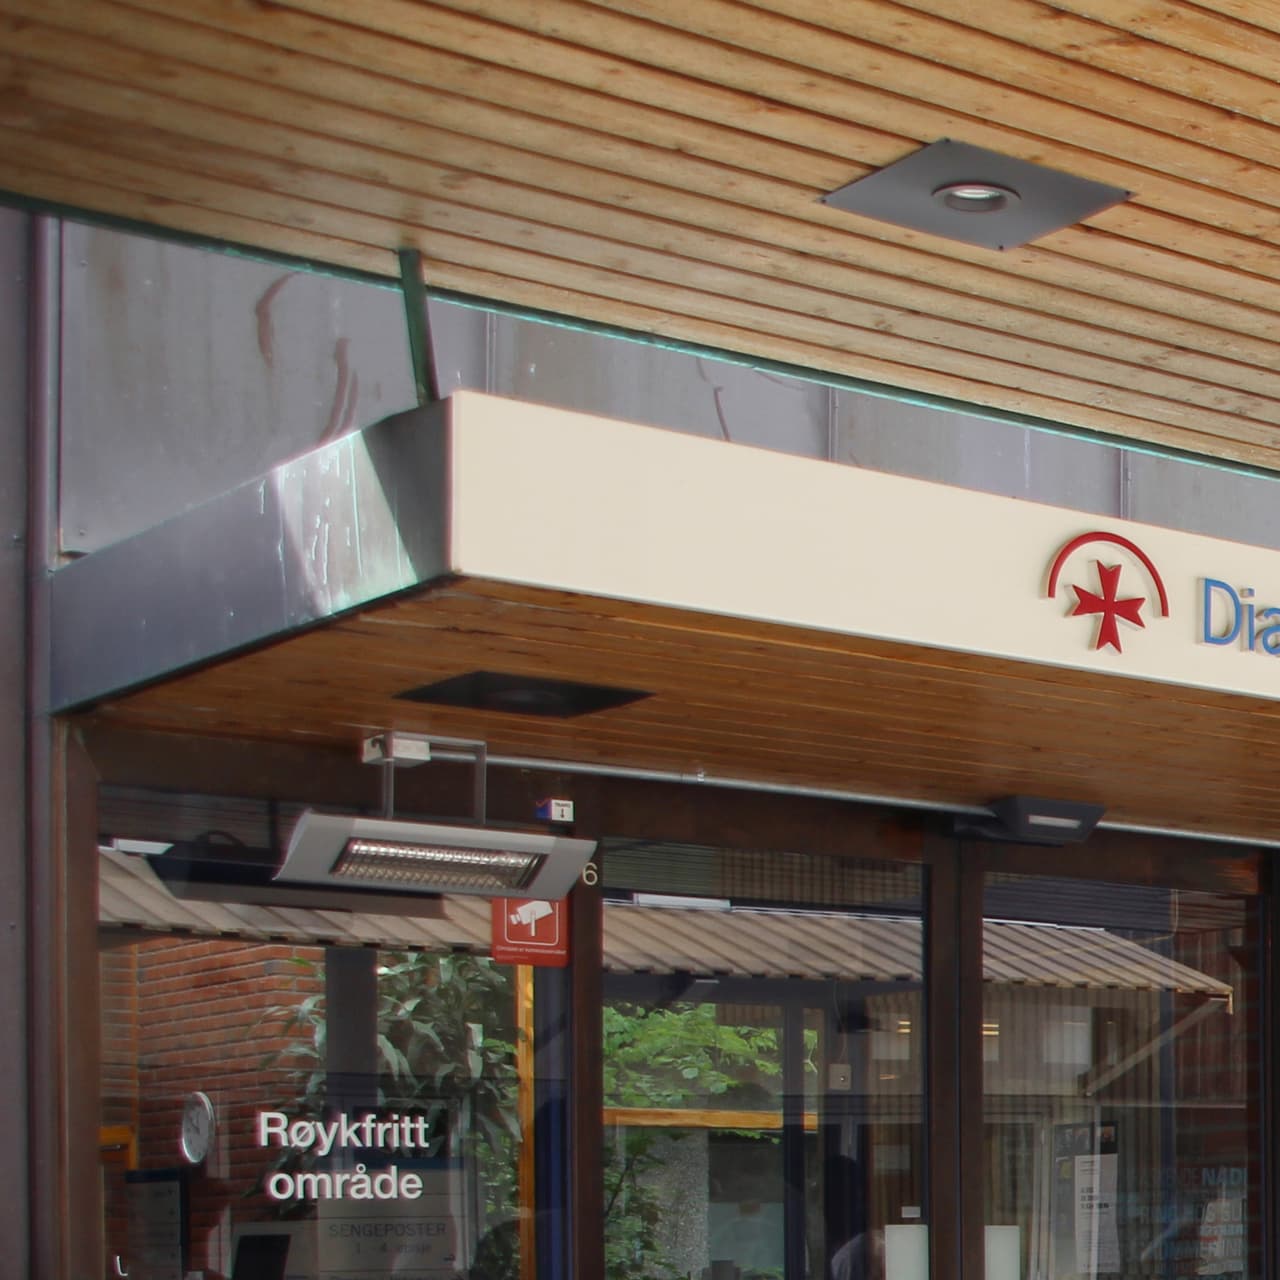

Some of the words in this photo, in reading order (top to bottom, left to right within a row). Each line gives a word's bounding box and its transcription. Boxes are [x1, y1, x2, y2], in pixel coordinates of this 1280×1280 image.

[582, 862, 599, 886] 6
[259, 1111, 430, 1156] Røykfritt
[269, 1163, 423, 1200] område
[328, 1222, 447, 1239] SENGEPOSTER
